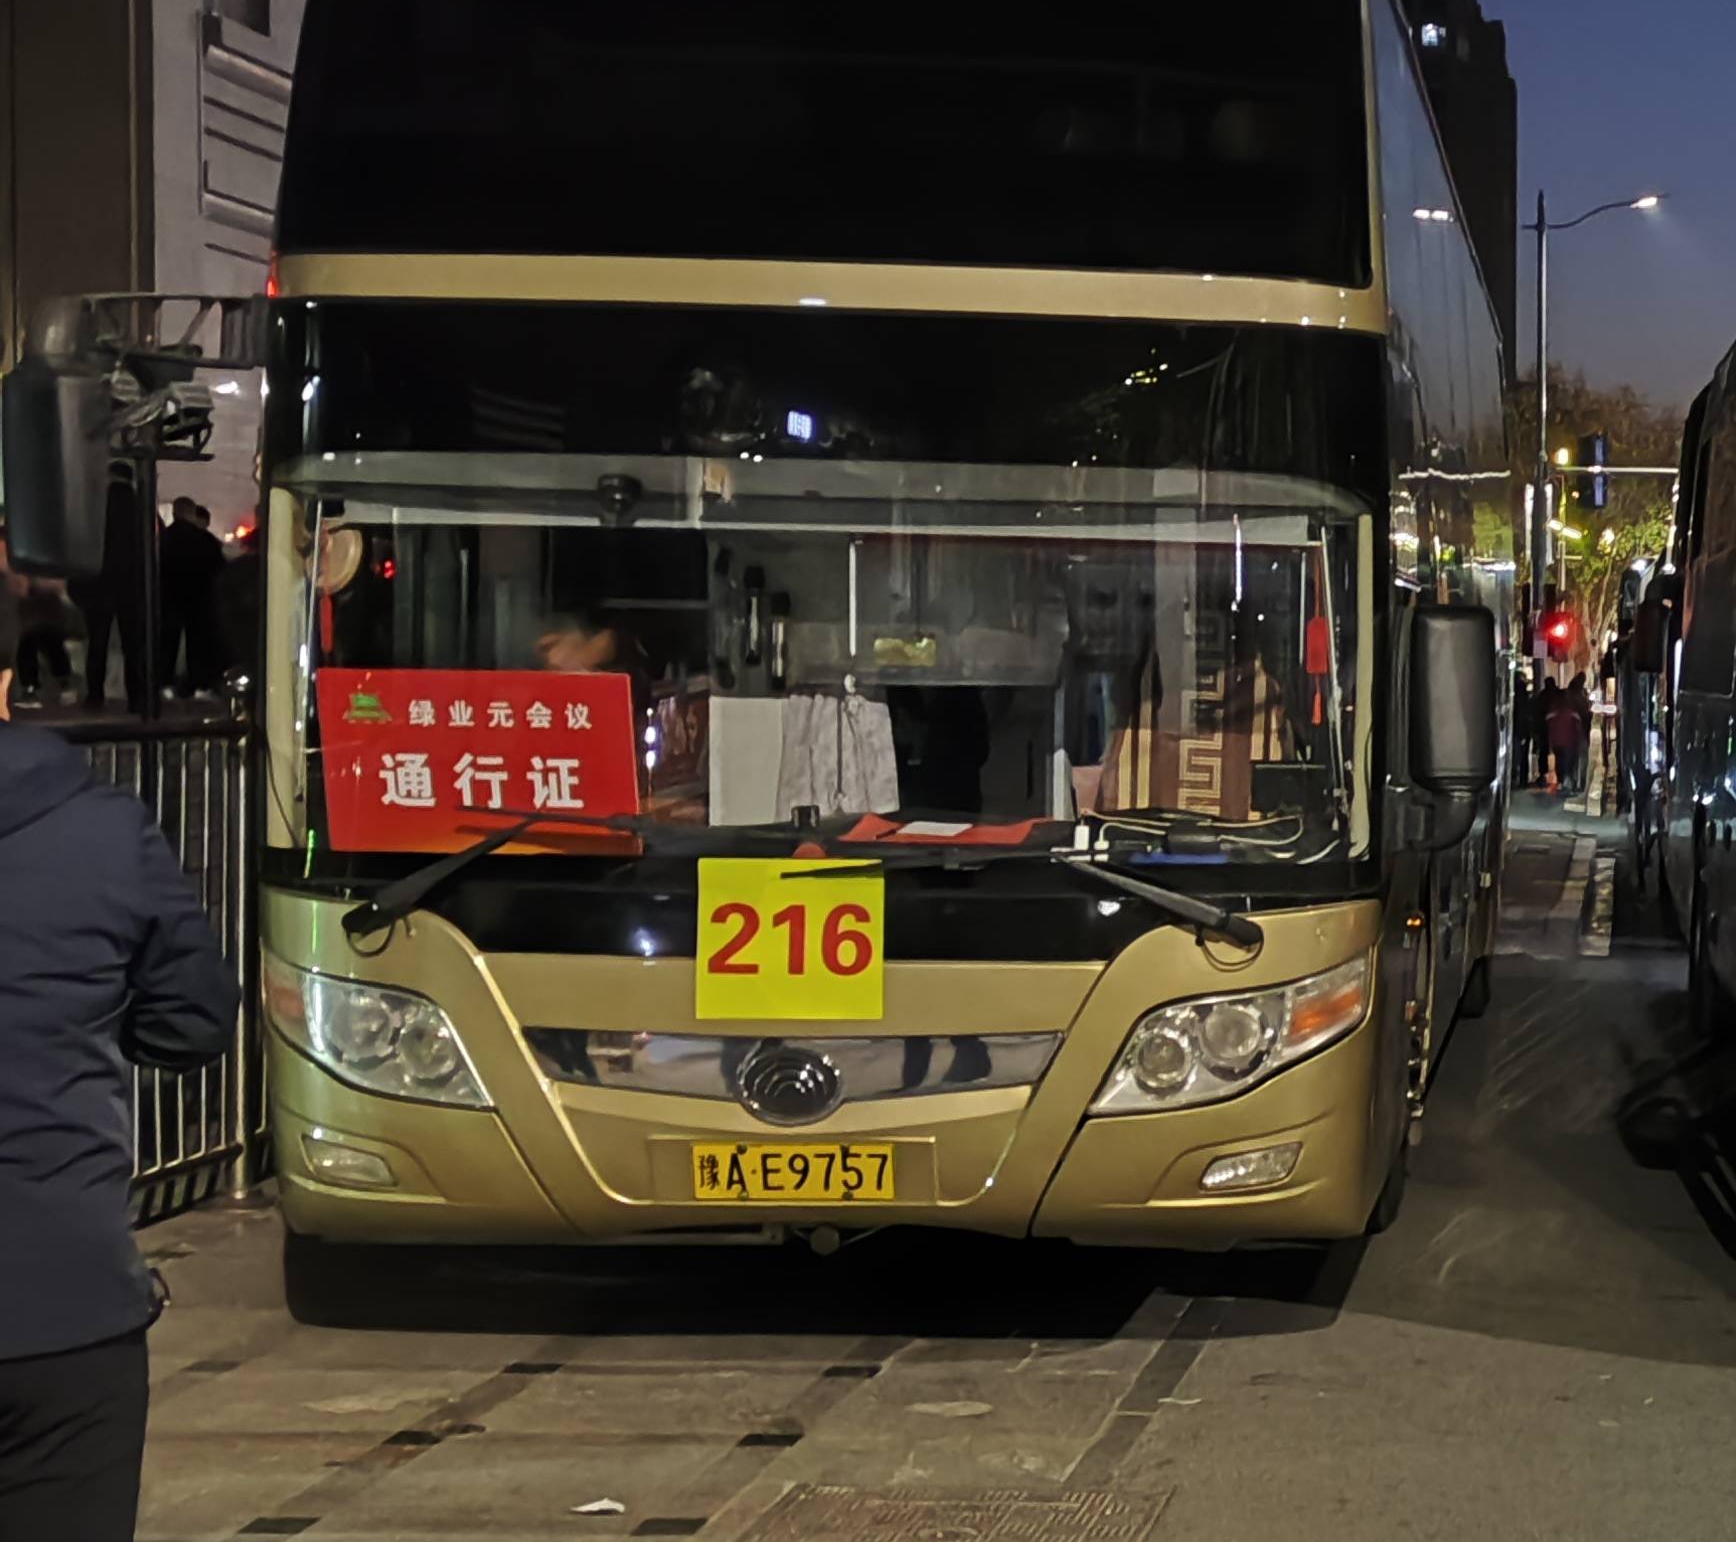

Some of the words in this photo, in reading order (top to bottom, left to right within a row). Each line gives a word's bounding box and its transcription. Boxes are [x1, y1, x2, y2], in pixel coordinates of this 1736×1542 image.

[408, 699, 592, 731] 绿业元会议
[379, 752, 585, 811] 通行证
[707, 901, 874, 976] 216
